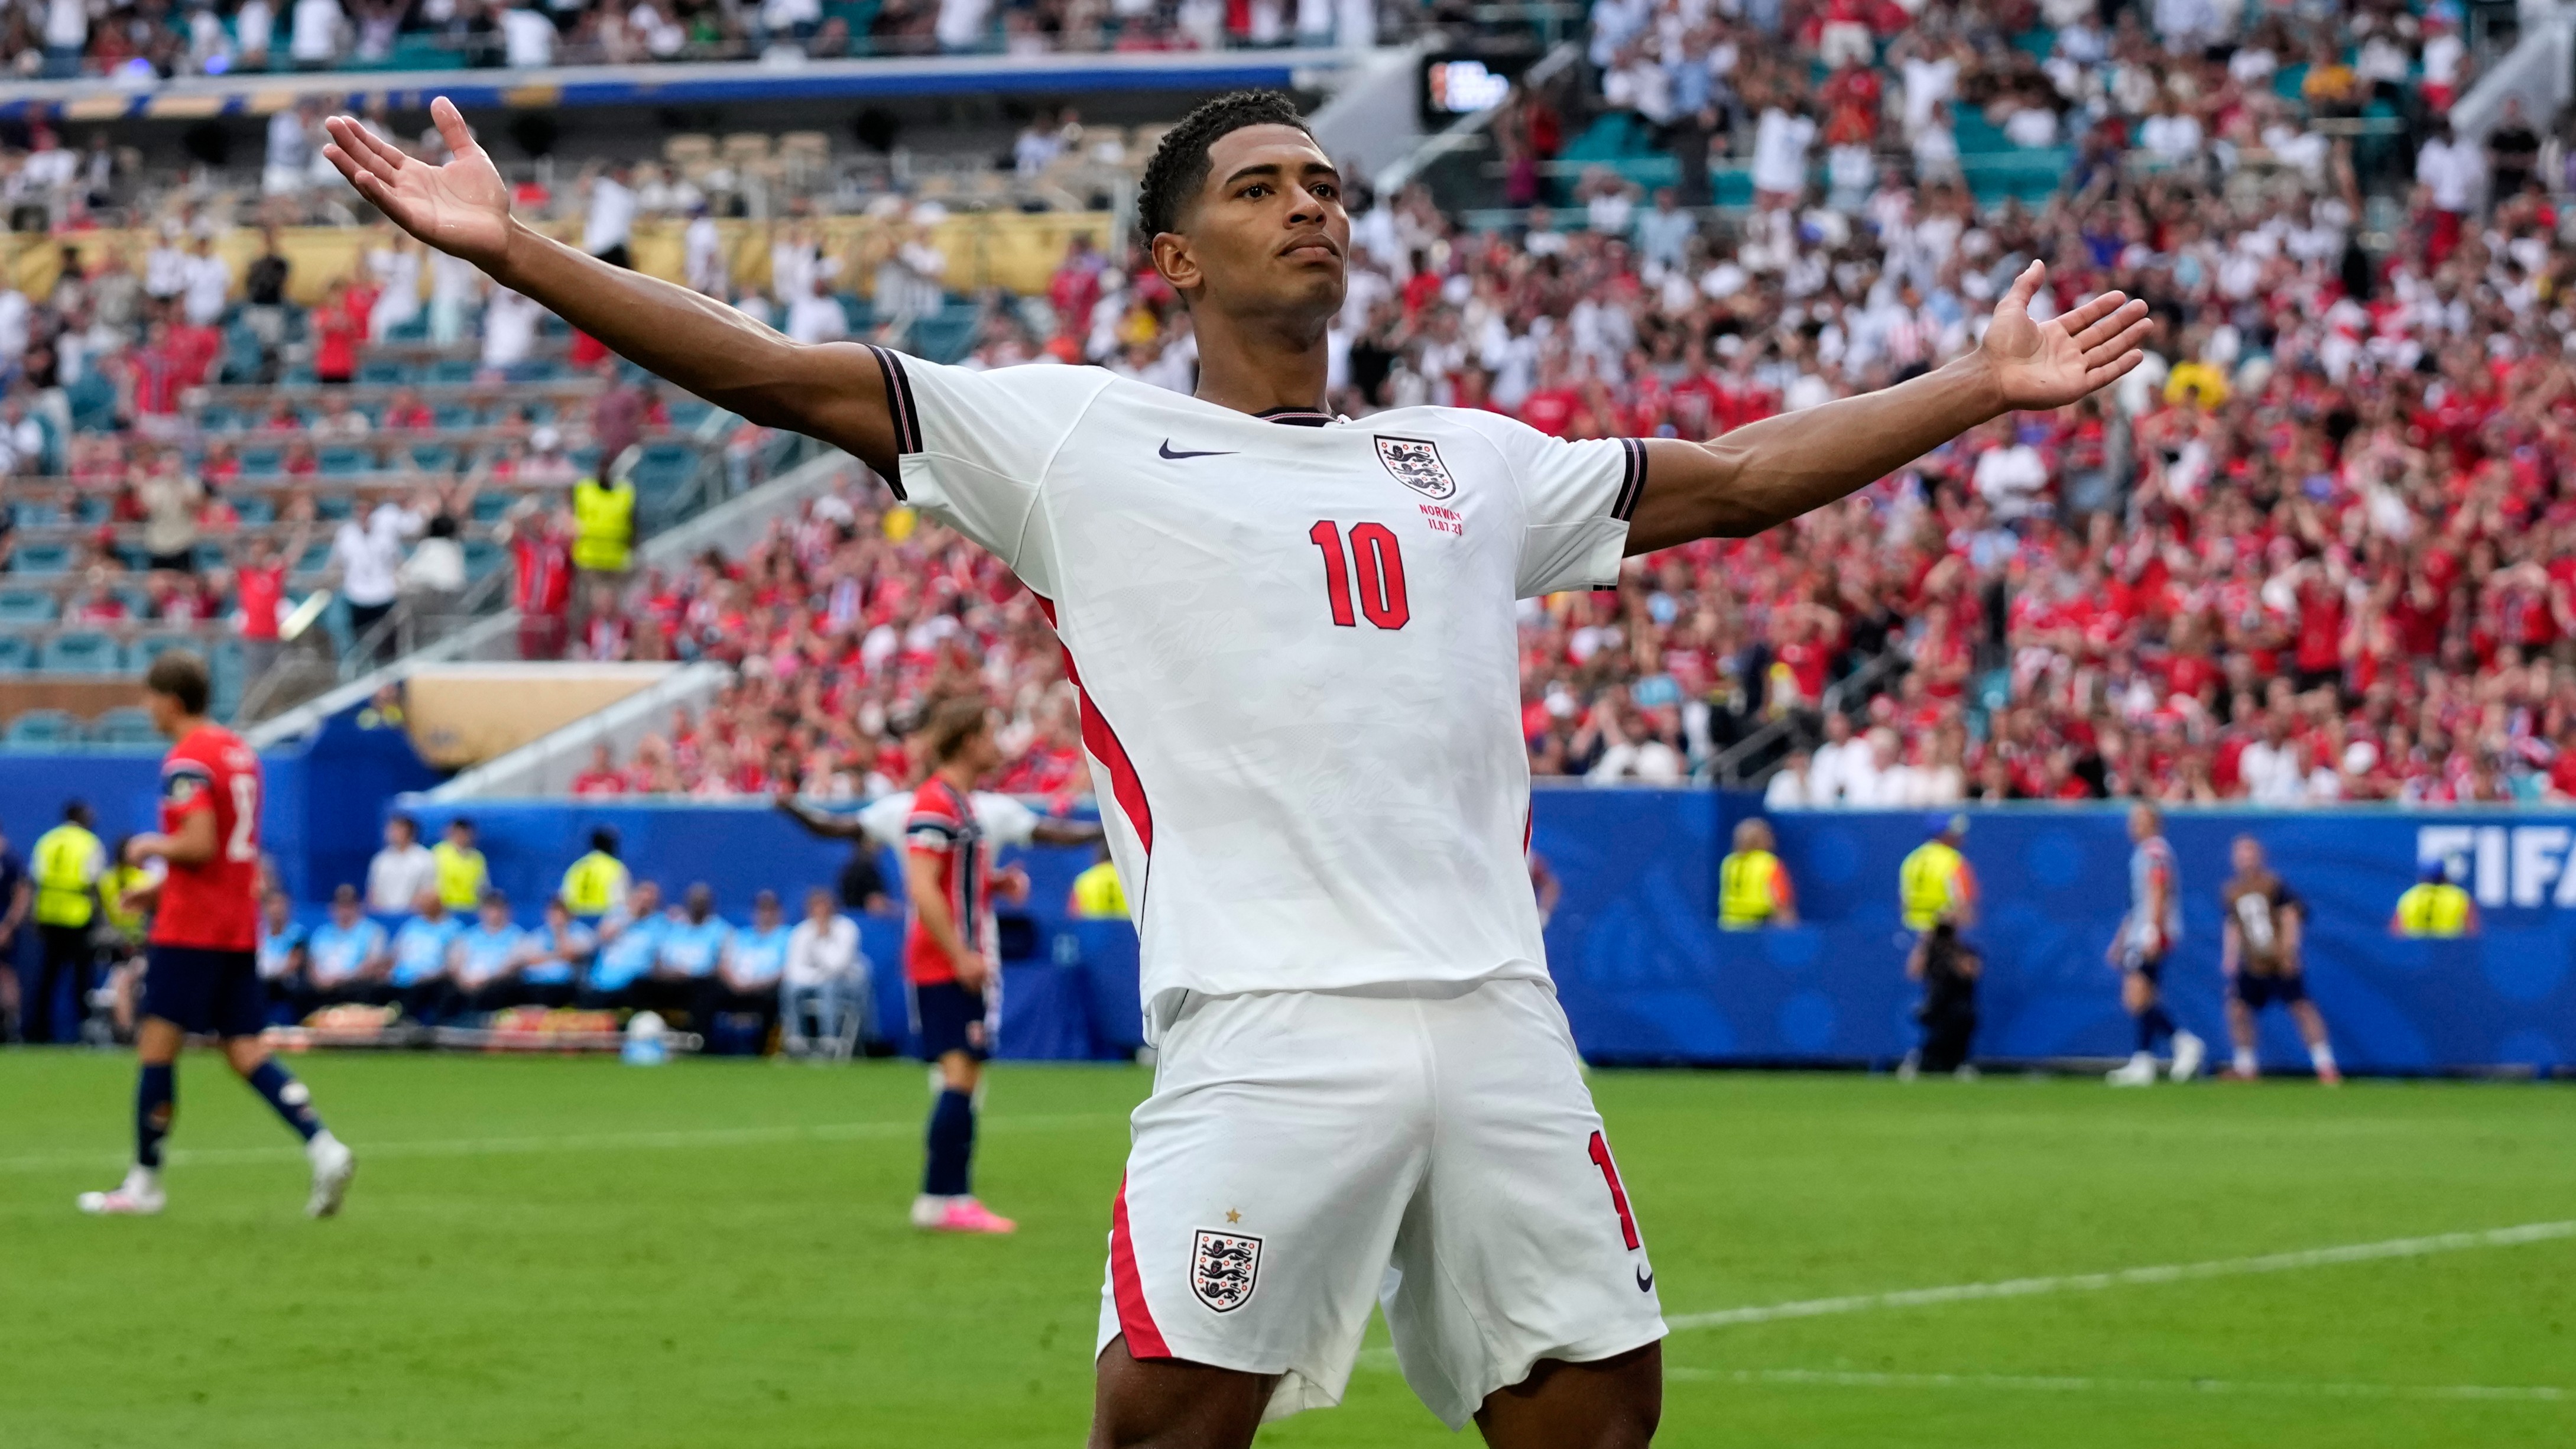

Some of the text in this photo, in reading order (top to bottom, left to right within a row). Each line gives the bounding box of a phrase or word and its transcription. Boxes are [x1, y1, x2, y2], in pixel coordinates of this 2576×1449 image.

[1419, 504, 1462, 521] NORWAY
[1309, 520, 1410, 630] 10
[1588, 1130, 1640, 1251] 1
